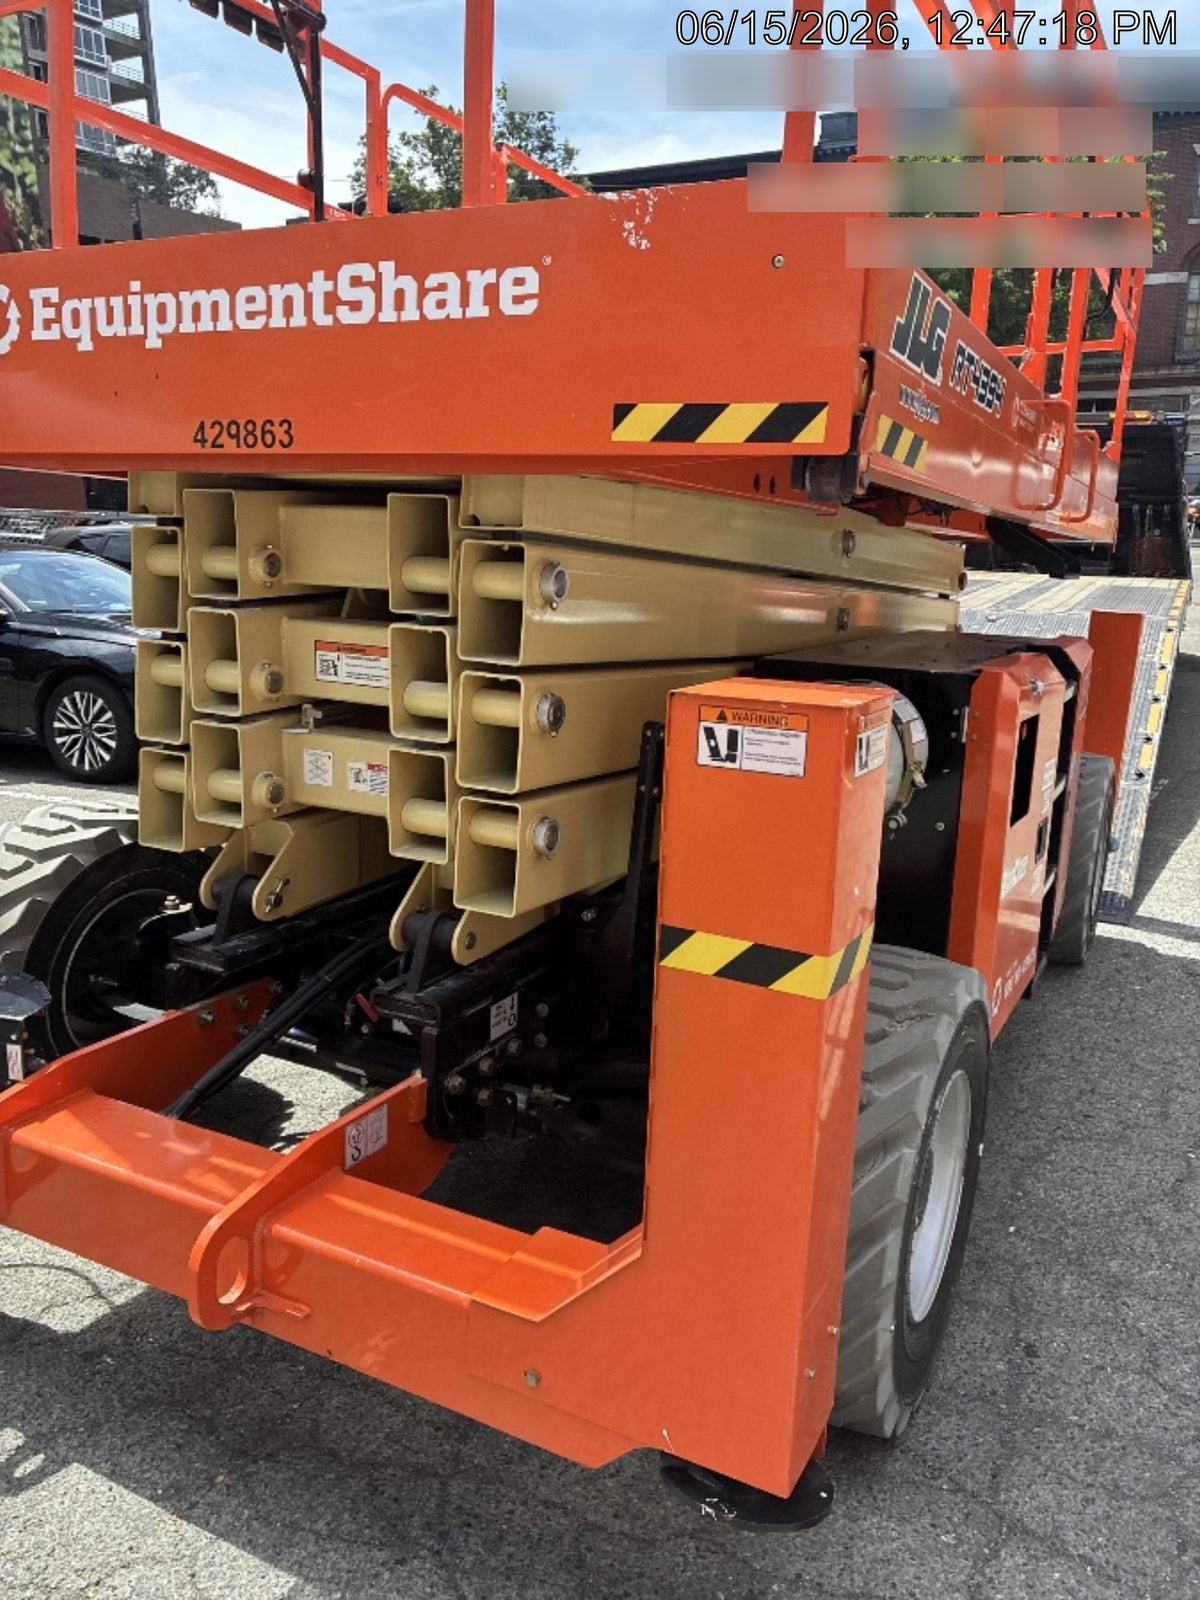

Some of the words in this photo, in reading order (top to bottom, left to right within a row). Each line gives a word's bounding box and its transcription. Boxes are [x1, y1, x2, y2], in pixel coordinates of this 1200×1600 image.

[29, 259, 540, 351] EquipmentShare
[889, 270, 952, 386] JLG
[193, 418, 294, 449] 429863
[731, 710, 789, 727] WARNING
